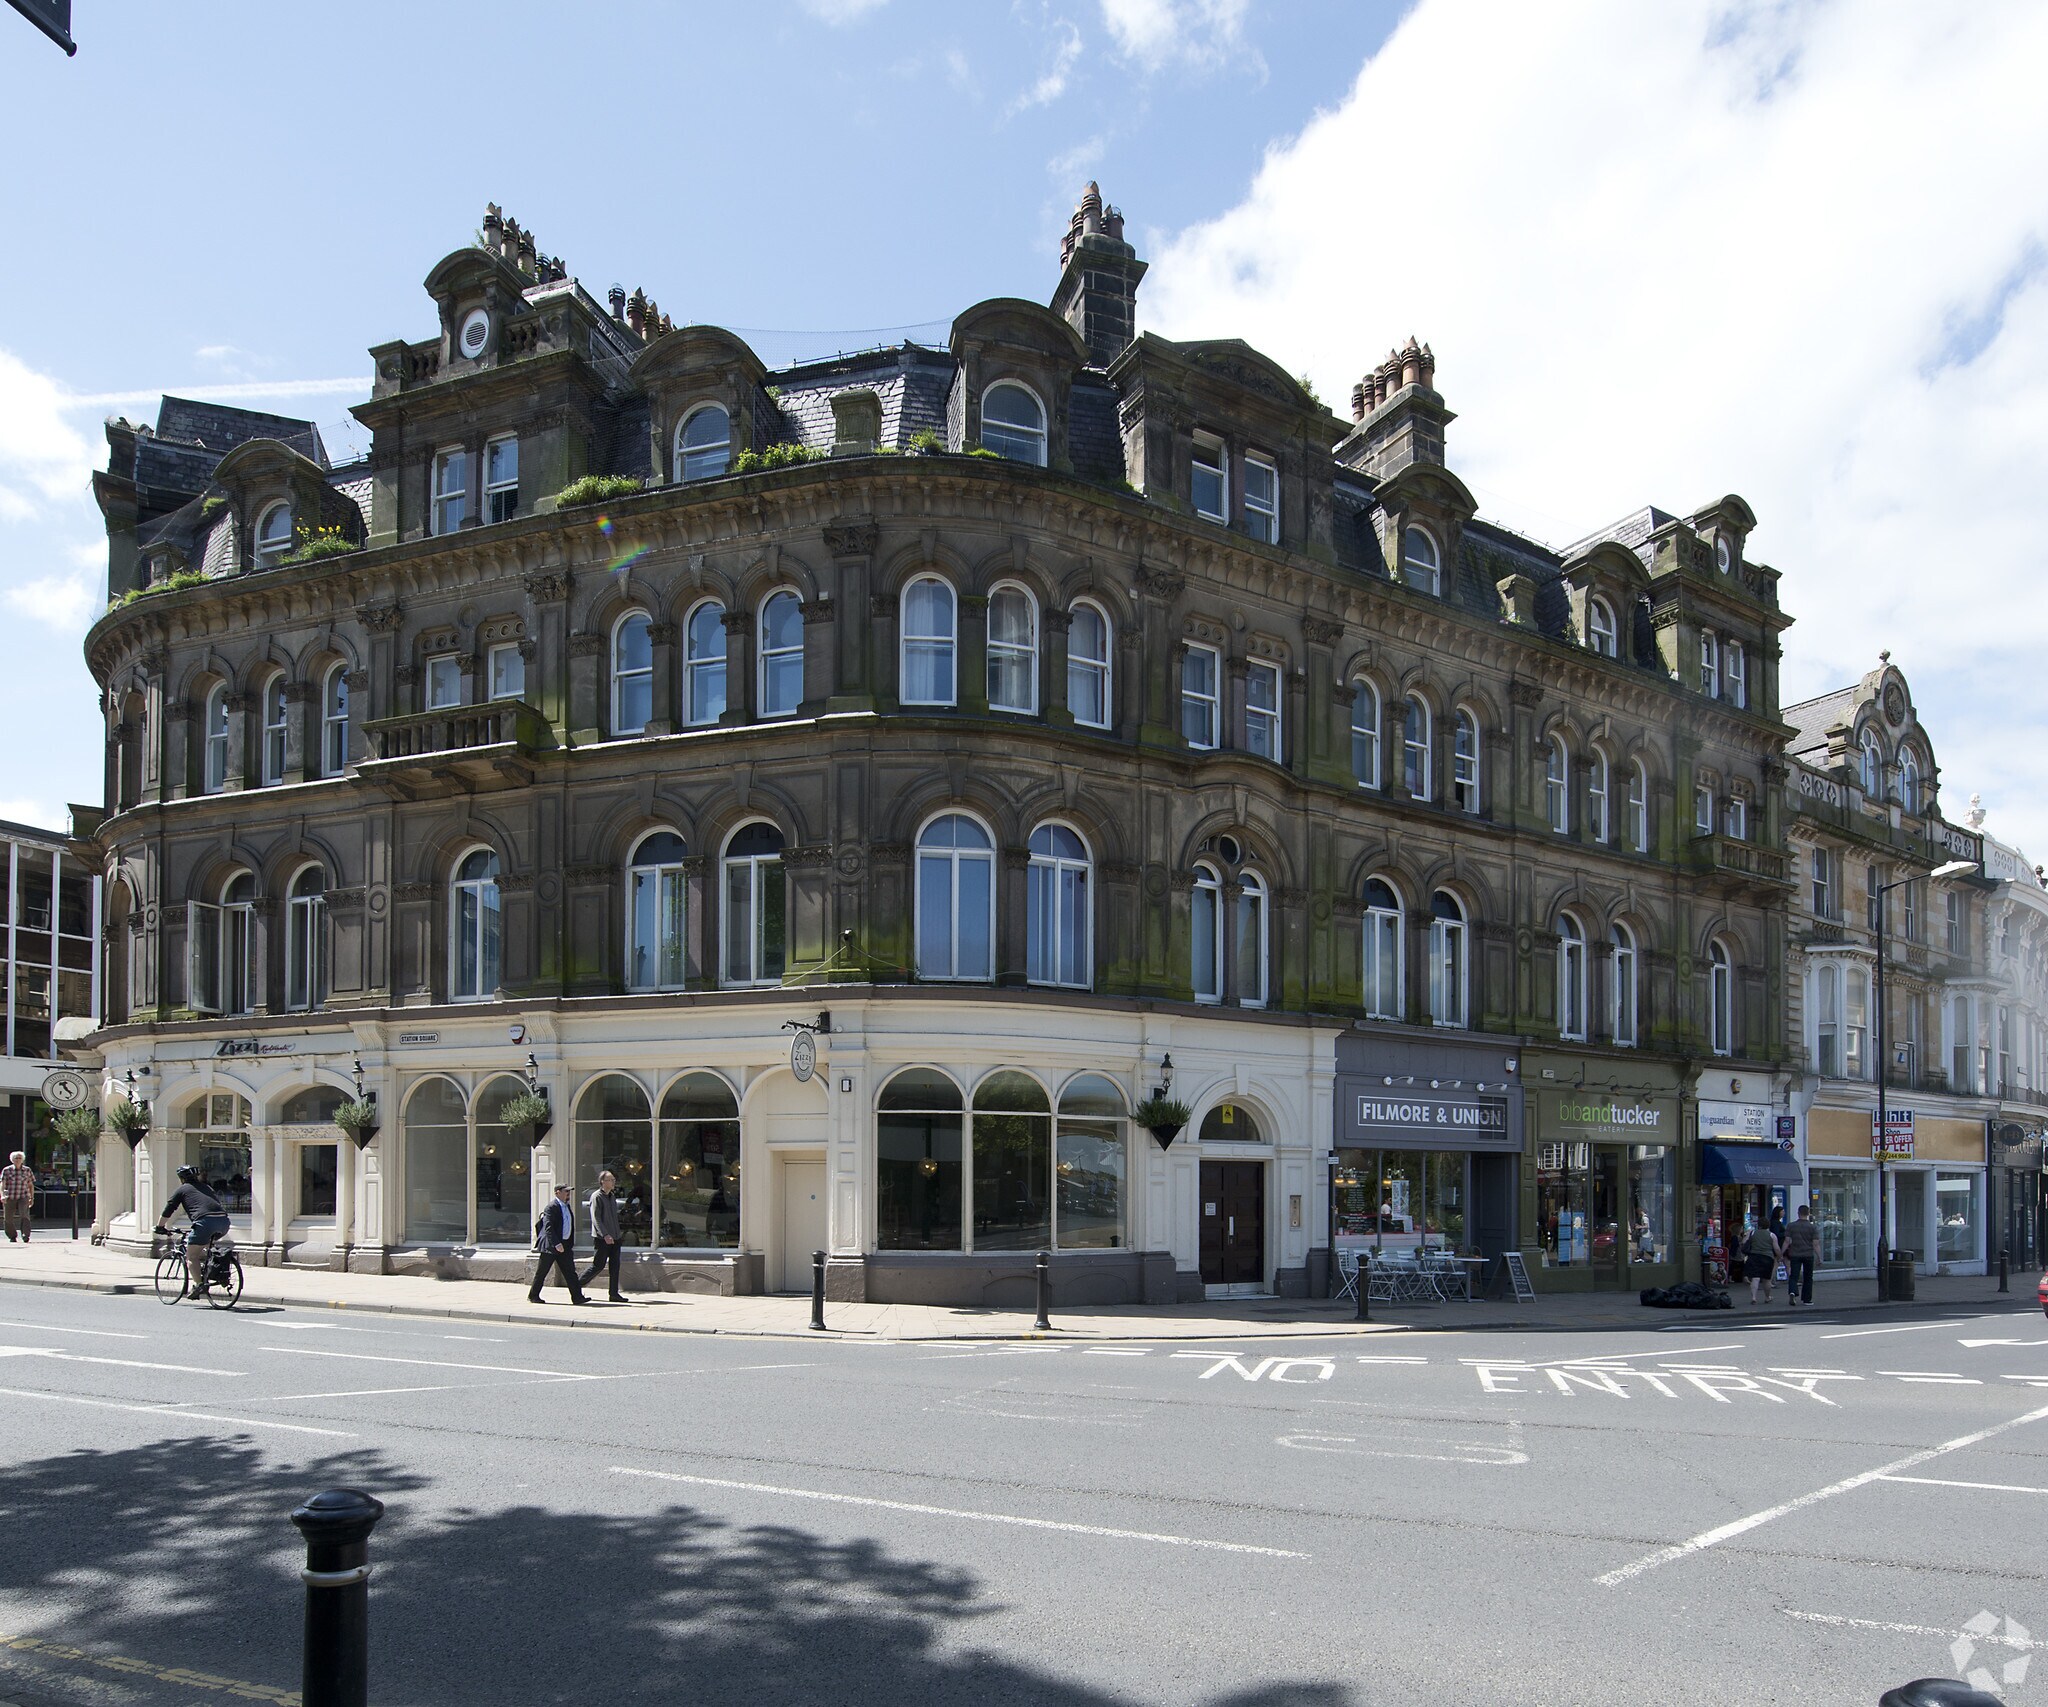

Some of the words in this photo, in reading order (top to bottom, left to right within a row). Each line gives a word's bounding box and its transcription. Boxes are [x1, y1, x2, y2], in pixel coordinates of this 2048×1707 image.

[216, 1039, 258, 1056] Zizzi
[794, 1050, 811, 1062] Zizzi
[1362, 1102, 1430, 1122] FILMORE
[1436, 1107, 1448, 1123] &
[1452, 1107, 1502, 1125] UNION
[1559, 1099, 1660, 1125] bibandtucker
[1743, 1108, 1765, 1117] STATION
[1746, 1117, 1762, 1126] NEWS
[1597, 1125, 1626, 1133] EATERY
[1894, 1135, 1912, 1143] OFFER
[1197, 1357, 1336, 1384] NO
[1474, 1366, 1842, 1408] ENTRY
